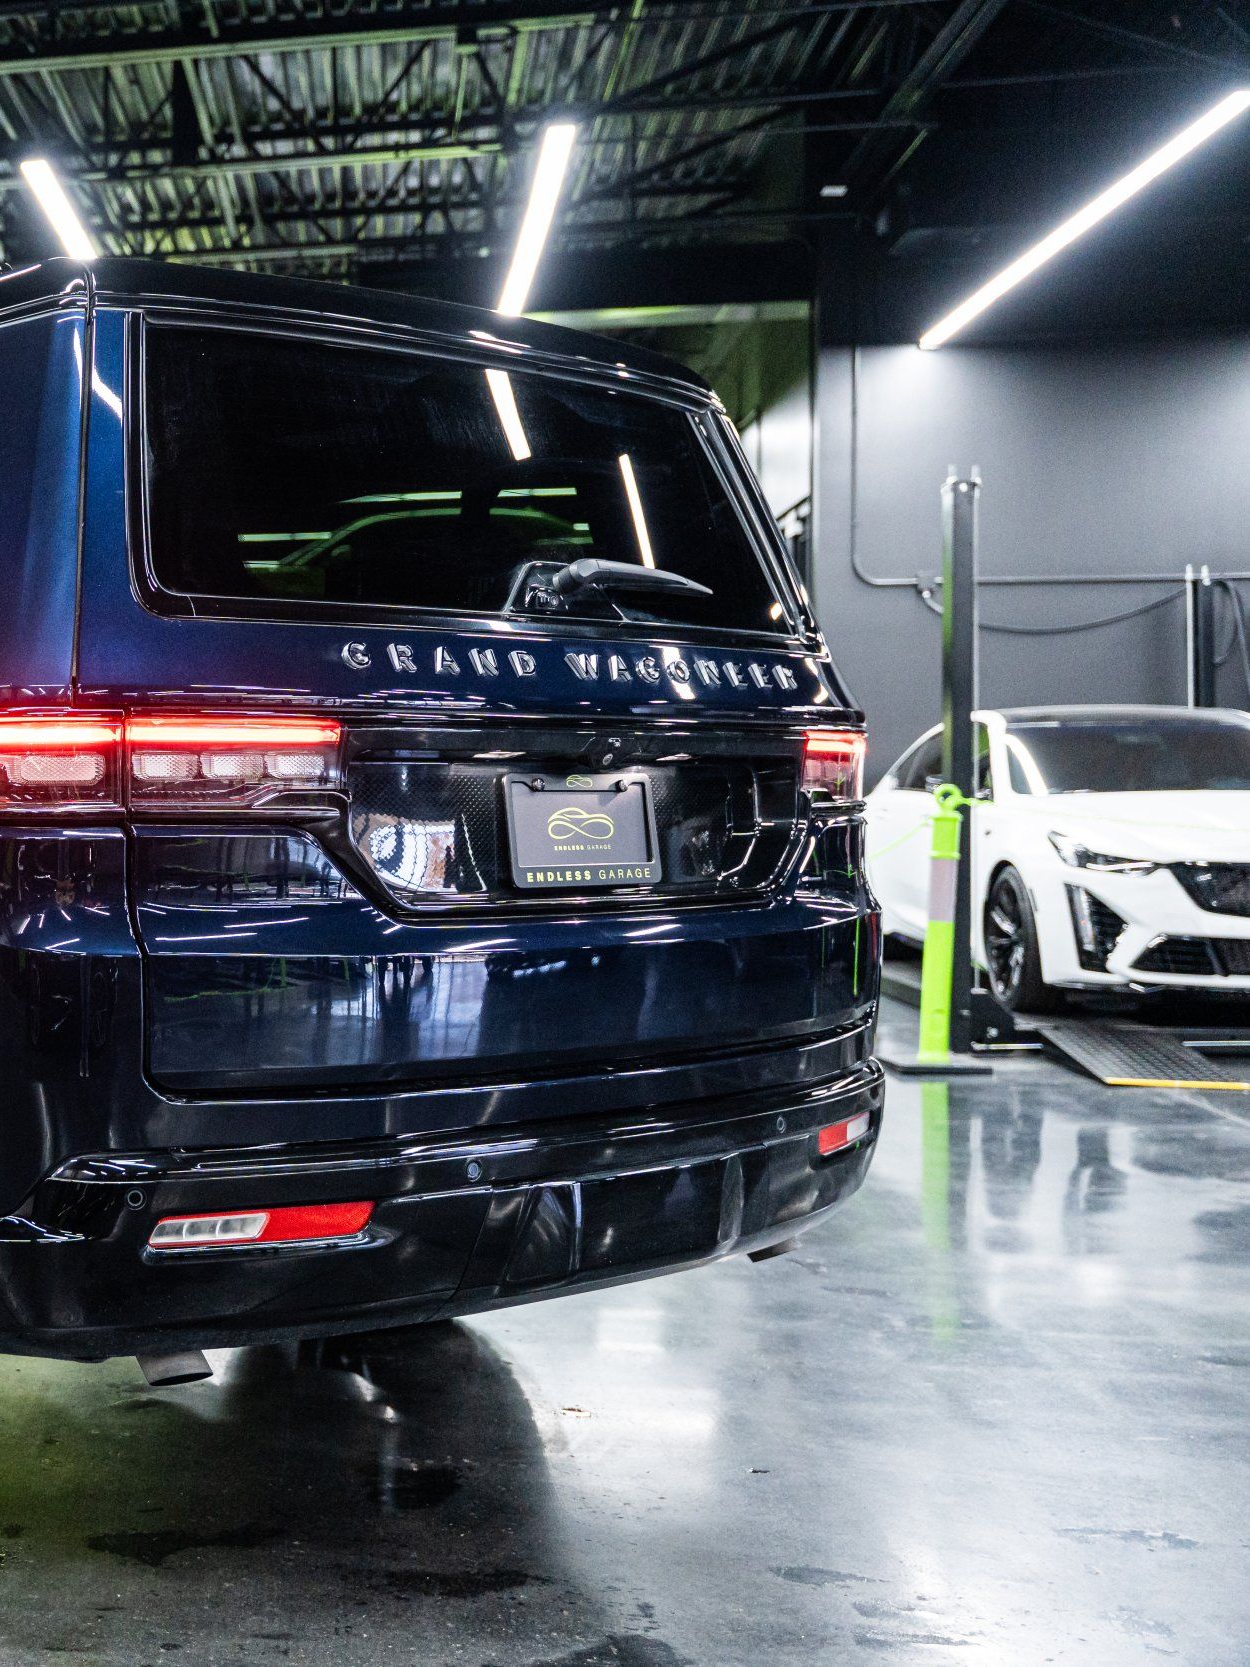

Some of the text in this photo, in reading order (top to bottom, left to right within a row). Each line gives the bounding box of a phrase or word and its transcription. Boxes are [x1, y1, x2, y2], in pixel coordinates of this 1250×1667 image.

[341, 641, 798, 690] GRAND WAGONEER
[526, 867, 651, 883] ENDLESS GARAGE
